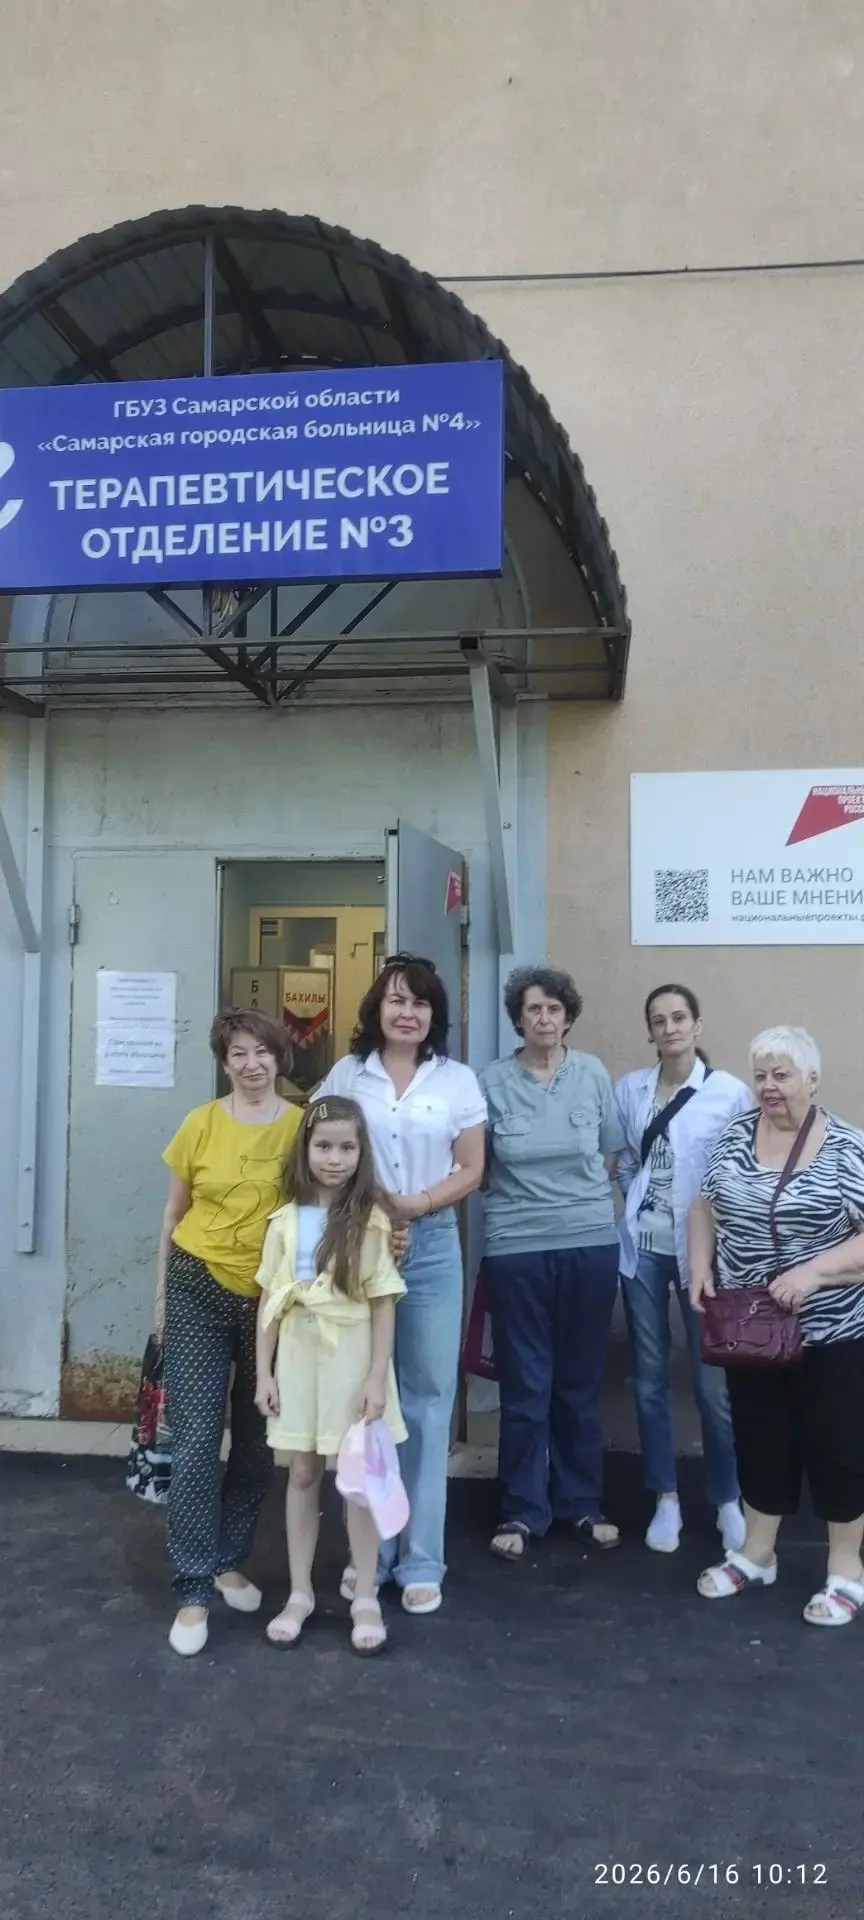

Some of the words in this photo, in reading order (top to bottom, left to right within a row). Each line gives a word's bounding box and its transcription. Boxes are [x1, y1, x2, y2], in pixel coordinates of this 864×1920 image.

[113, 397, 167, 418] ГБУЗ
[172, 390, 299, 417] Самарской
[304, 388, 401, 408] области
[37, 431, 175, 455] «Самарская
[180, 424, 298, 448] городская
[303, 417, 416, 438] больница
[49, 461, 450, 511] ТЕРАПЕВТИЧЕСКОЕ
[81, 517, 328, 565] ОТДЕЛЕНИЕ
[339, 513, 415, 550] №3
[731, 868, 775, 884] НАМ
[781, 867, 854, 883] ВАЖНО
[731, 890, 787, 906] ВАШЕ
[285, 992, 327, 1004] БАХИЛЫ
